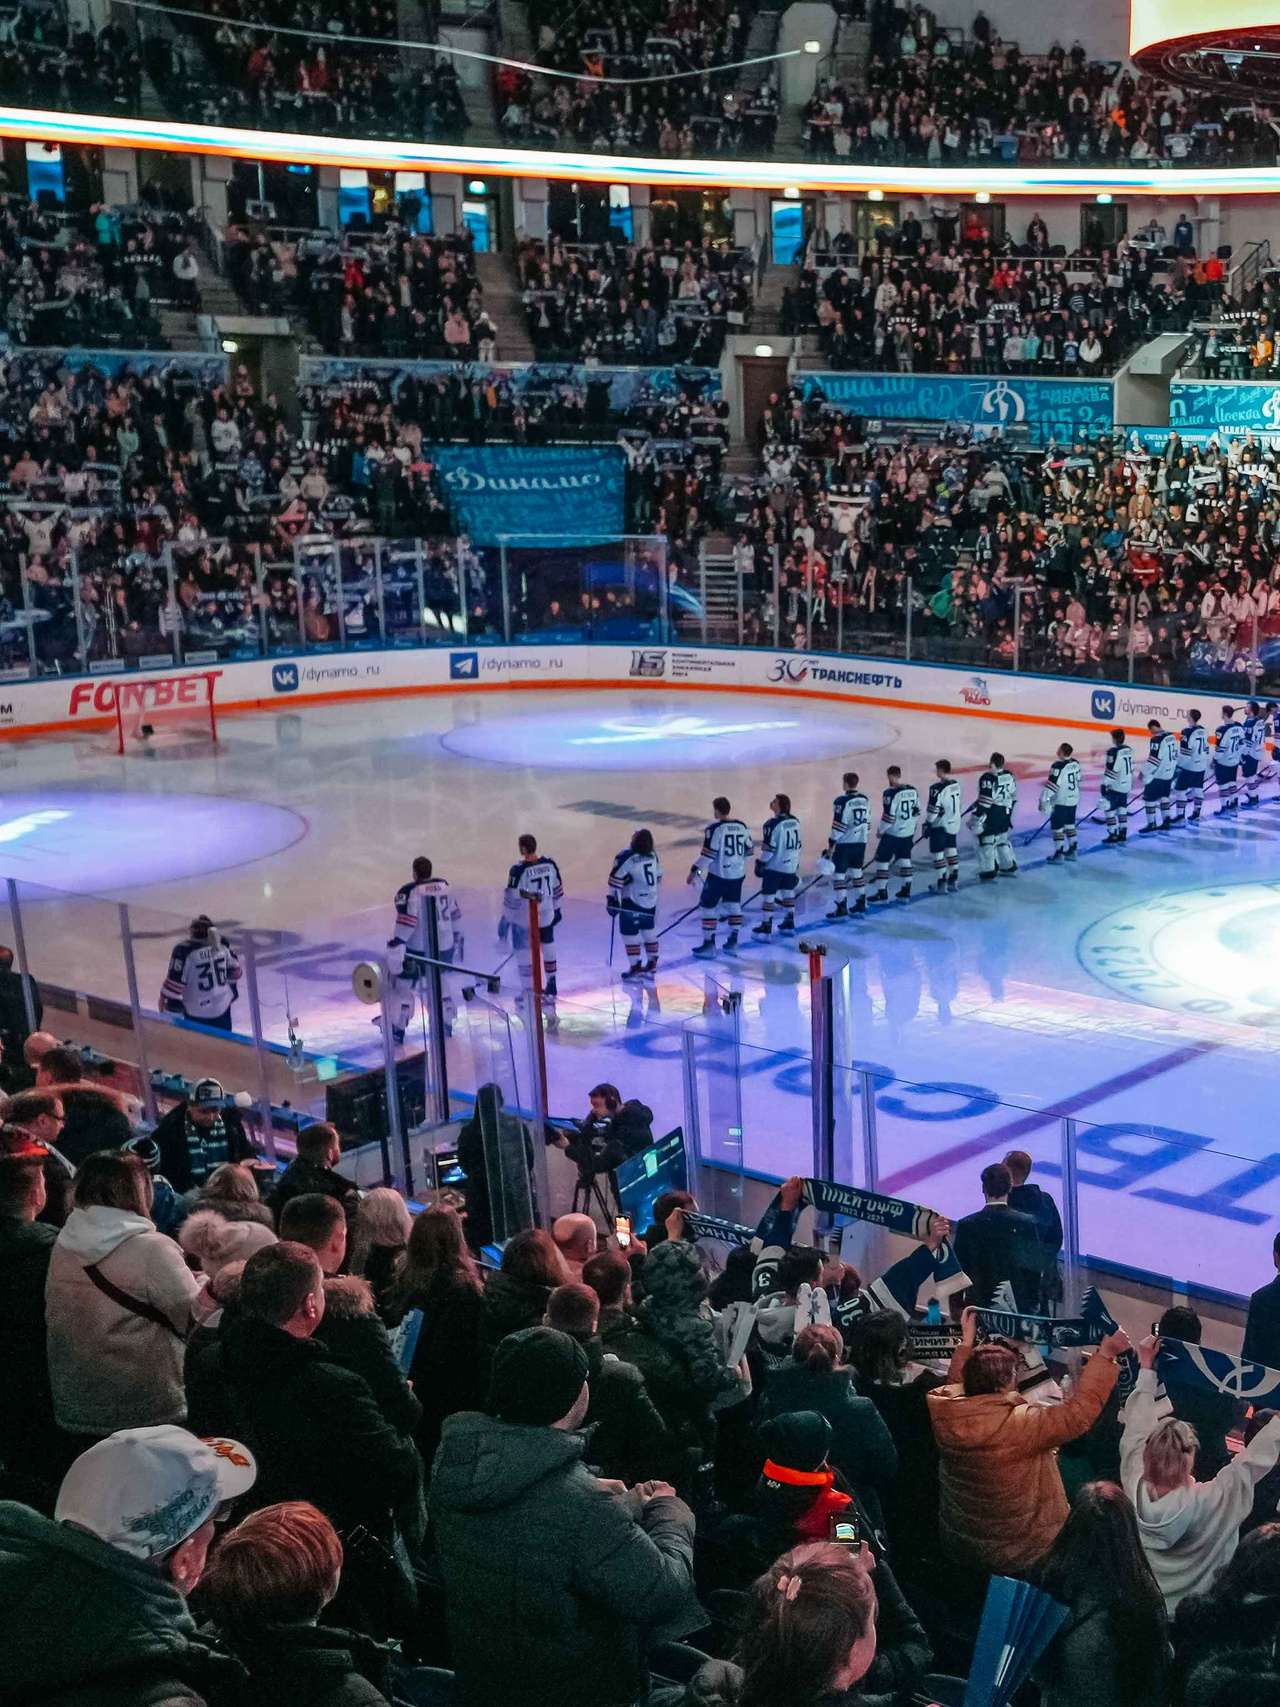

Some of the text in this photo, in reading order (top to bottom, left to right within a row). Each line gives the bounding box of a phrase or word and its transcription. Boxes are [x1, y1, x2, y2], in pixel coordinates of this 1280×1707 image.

[1210, 404, 1262, 424] Москва
[445, 466, 601, 491] Динамо
[811, 667, 903, 689] ТРАНСНЕФТЬ
[69, 670, 223, 715] FONBET
[195, 957, 227, 992] 36
